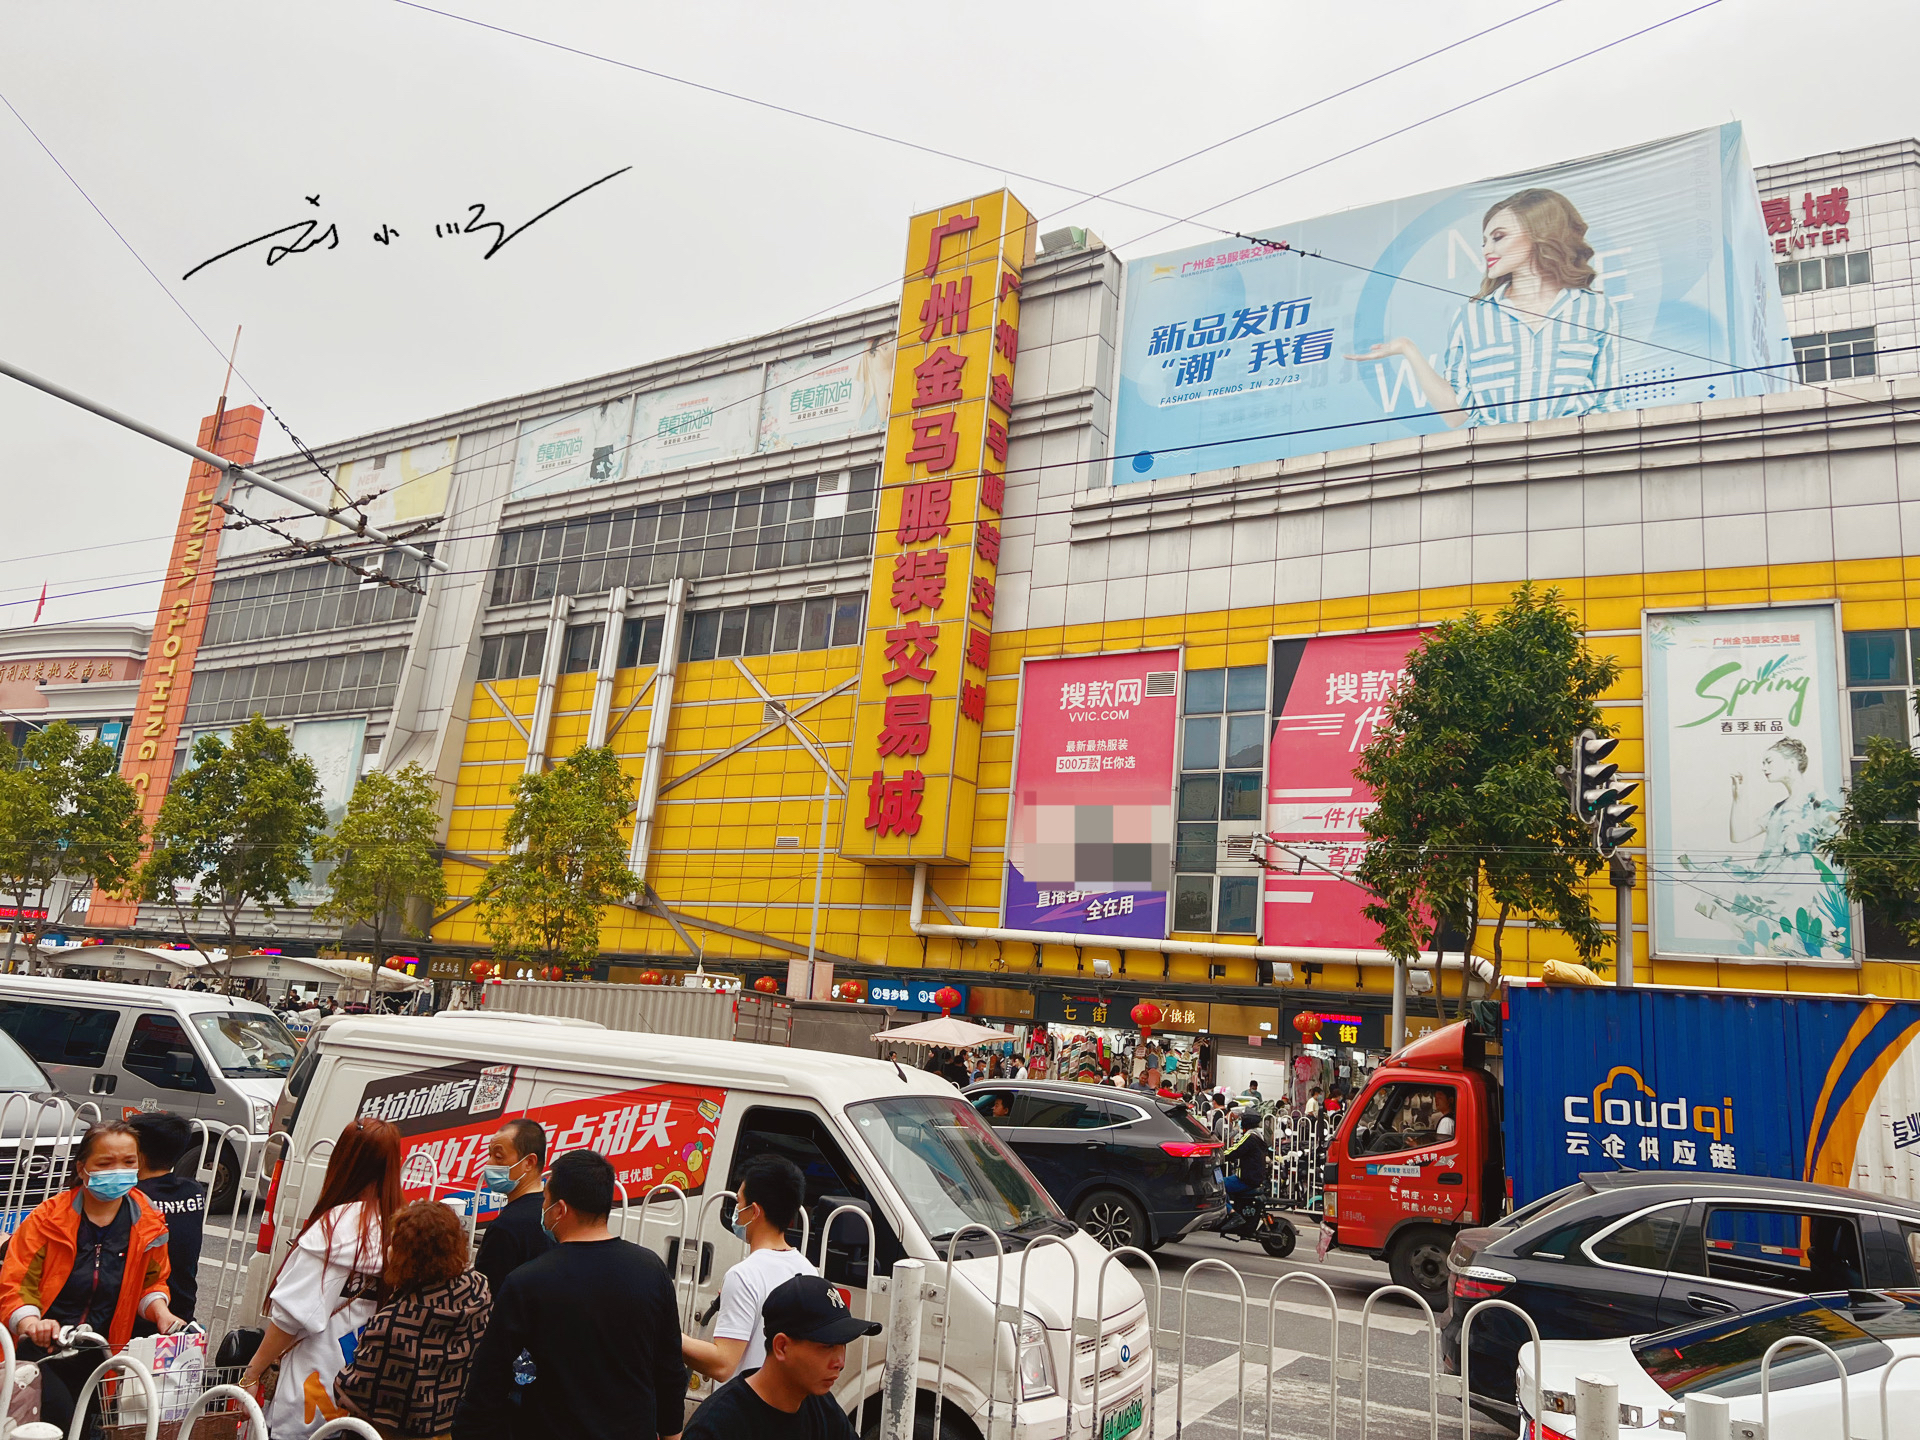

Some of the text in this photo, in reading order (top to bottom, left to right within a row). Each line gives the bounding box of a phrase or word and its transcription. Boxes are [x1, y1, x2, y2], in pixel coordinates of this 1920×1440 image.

[1148, 297, 1313, 357] 新品发布
[1160, 374, 1301, 406] FASHION TRENDS IN 22/23
[961, 271, 1022, 724] 广州金马服装交易城
[177, 490, 214, 588] JINMA
[864, 214, 979, 838] 广州金马服装交易城
[1713, 634, 1801, 645] 广州金马服装交易城
[137, 597, 190, 762] CLOTHING
[1060, 679, 1142, 710] 搜款网
[1675, 660, 1811, 728] Spring
[1069, 710, 1129, 723] VVIC.COM
[1721, 720, 1784, 733] 春季新品
[1066, 739, 1129, 752] 最新最热服装
[1058, 756, 1136, 771] 500万款 任你选
[1086, 895, 1135, 922] 全在用
[359, 1078, 478, 1123] 货拉拉搬家
[1565, 1132, 1737, 1170] 云企供应链
[1433, 1193, 1439, 1202] 3
[1444, 1193, 1453, 1204] 人
